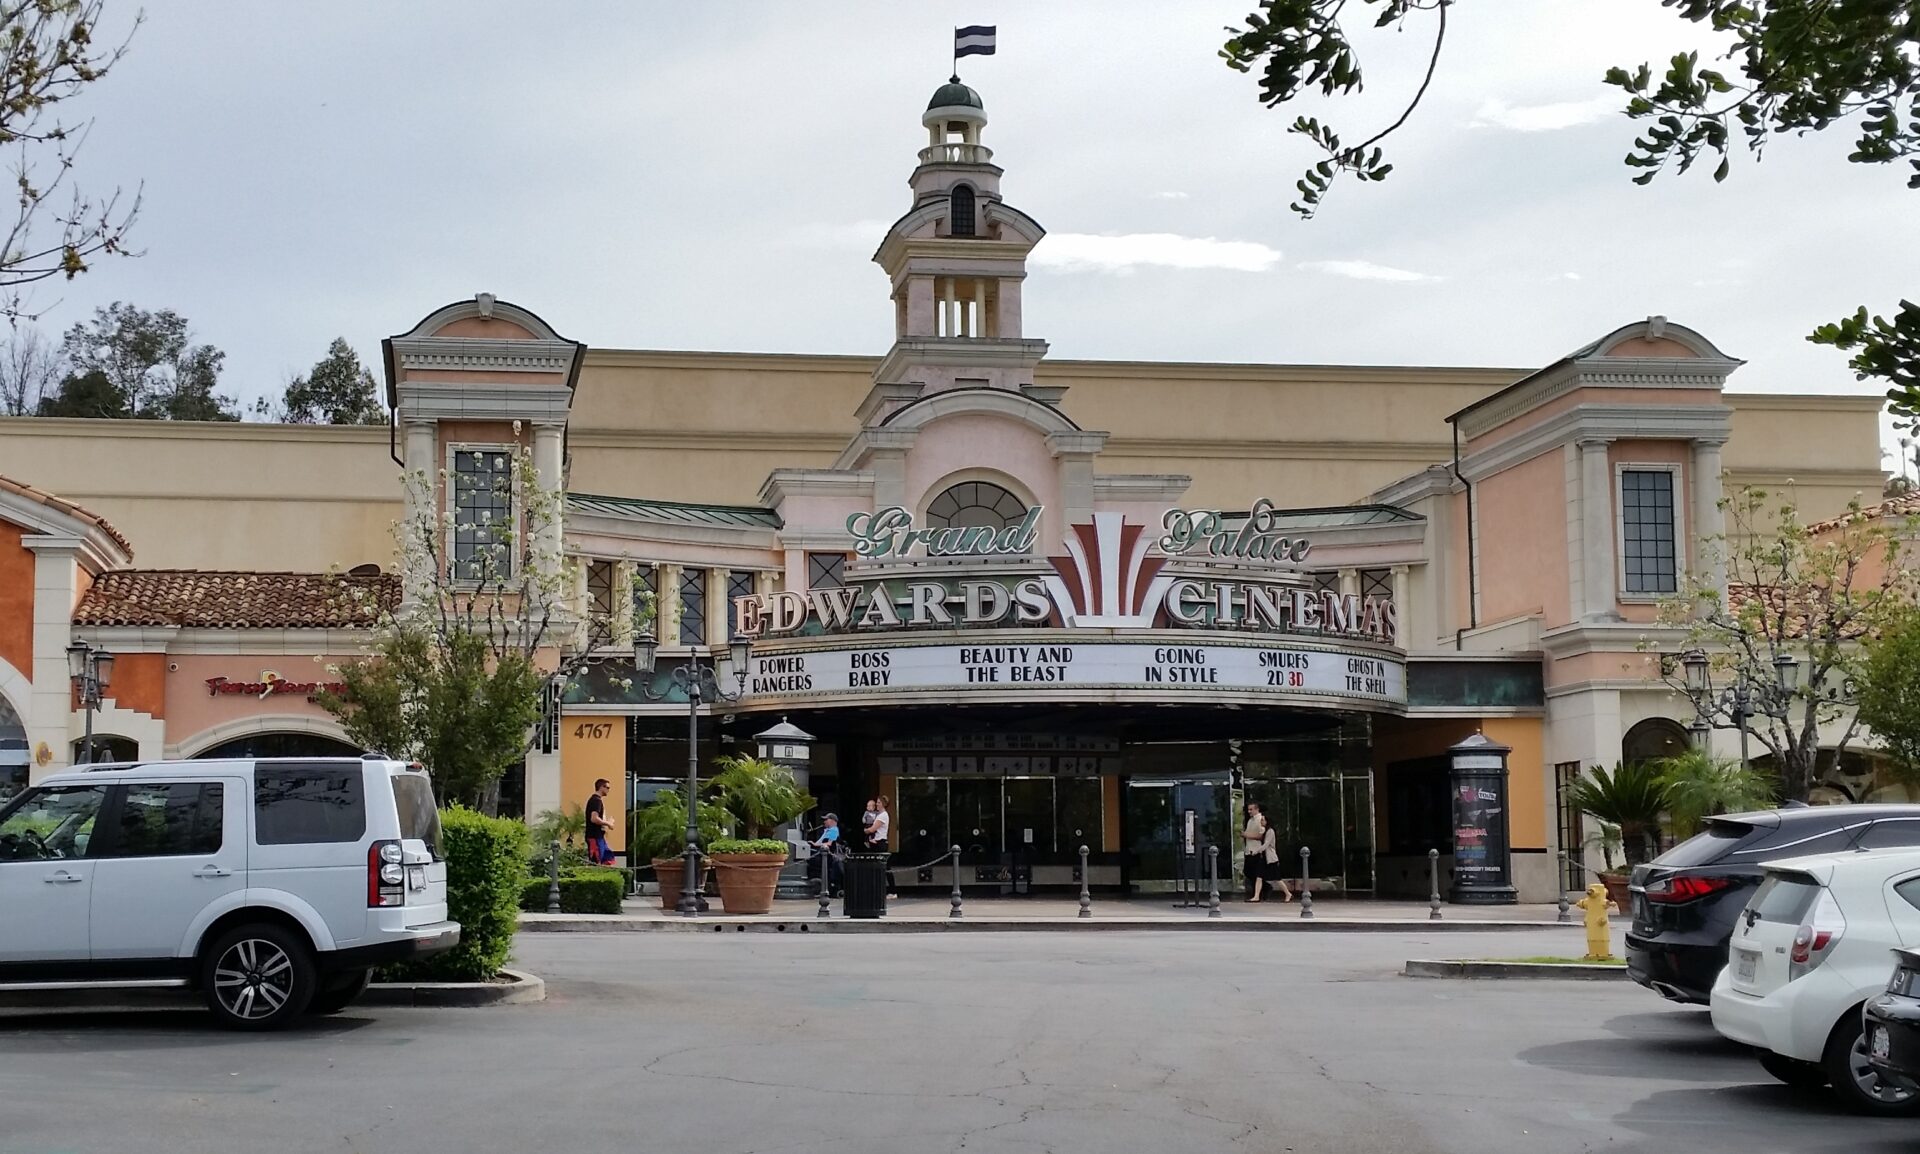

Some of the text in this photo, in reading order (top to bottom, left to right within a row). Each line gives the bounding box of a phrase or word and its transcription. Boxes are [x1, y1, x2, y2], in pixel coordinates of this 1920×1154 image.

[846, 497, 1312, 564] Grand Palace
[733, 578, 1397, 643] EDWARDS CINEMAS
[851, 652, 890, 669] BOSS
[960, 647, 1073, 665] BEAUTY AND
[1154, 648, 1205, 664] GOING
[1259, 651, 1309, 669] SMURFS
[760, 657, 804, 675] POWER
[965, 666, 1068, 683] THE BEAST
[1145, 666, 1218, 684] IN STYLE
[1348, 658, 1385, 677] GHOST IN
[753, 674, 812, 694] RANGERS
[849, 669, 891, 687] BABY
[1267, 670, 1304, 687] 2D 3D
[1345, 675, 1387, 695] THE SHELL
[574, 723, 613, 739] 4767
